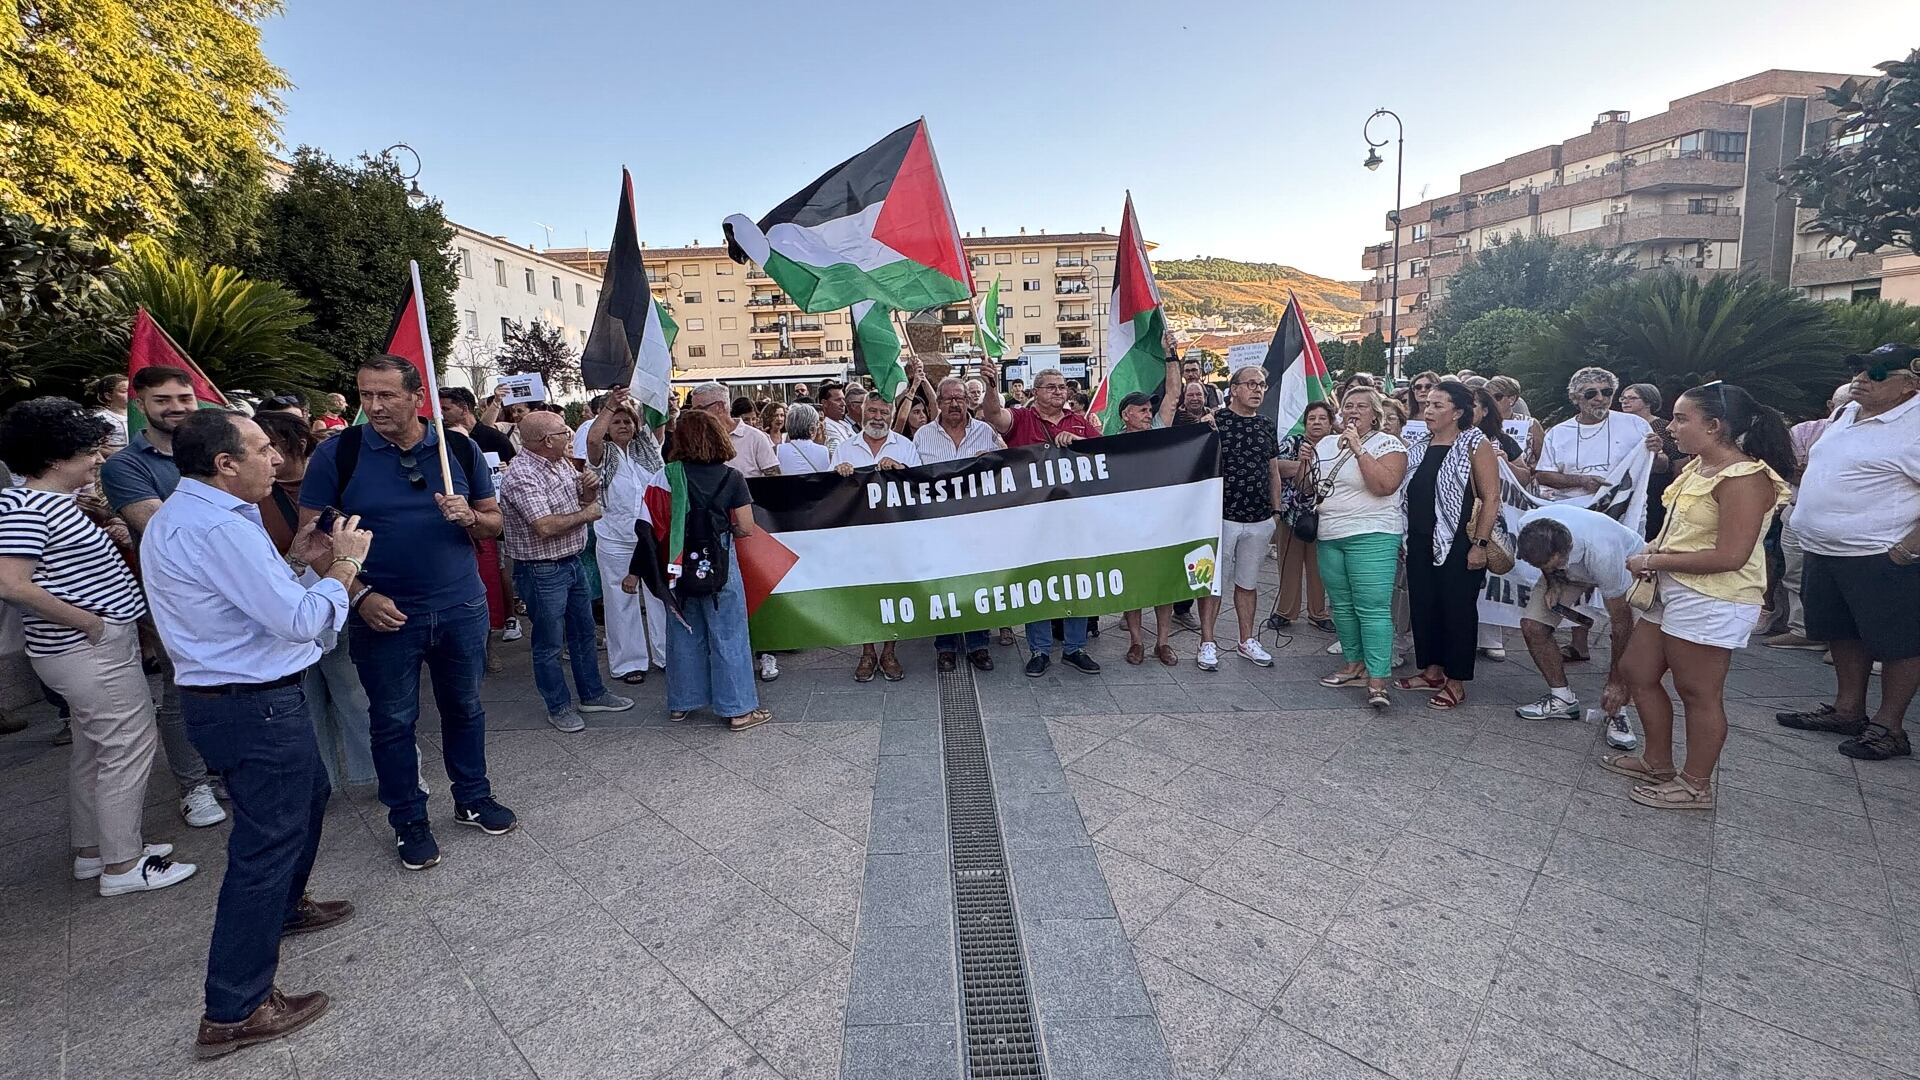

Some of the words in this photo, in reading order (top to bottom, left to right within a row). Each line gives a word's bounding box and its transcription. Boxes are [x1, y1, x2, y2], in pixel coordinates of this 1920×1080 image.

[867, 466, 1017, 509] PALESTINA
[1029, 453, 1110, 489] LIBRE
[879, 597, 915, 624] NO
[929, 592, 962, 621] AL
[974, 568, 1124, 614] GENOCIDIO
